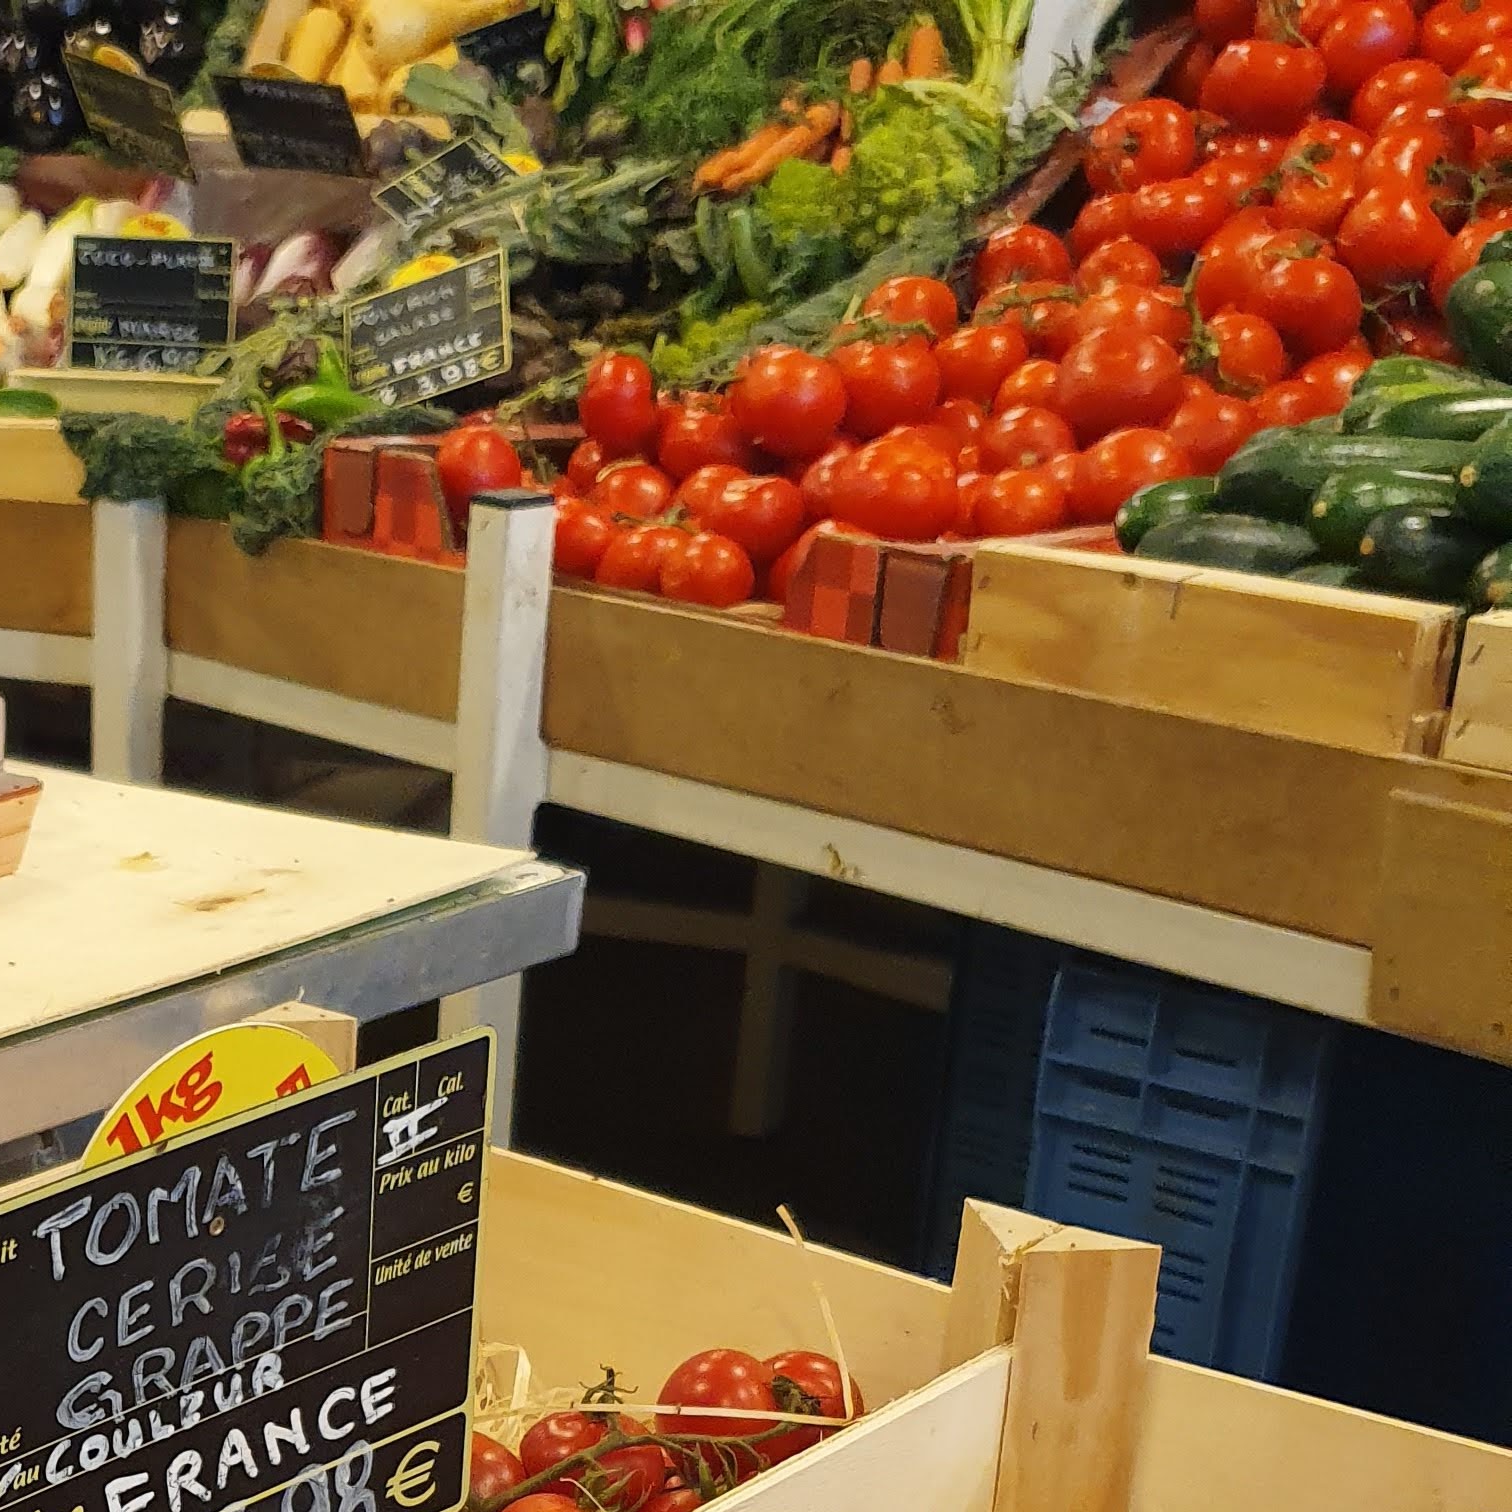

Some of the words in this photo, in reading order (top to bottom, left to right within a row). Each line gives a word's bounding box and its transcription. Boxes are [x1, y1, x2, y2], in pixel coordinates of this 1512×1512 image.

[392, 329, 484, 375] FRANCE
[106, 1050, 223, 1156] 1kg
[382, 1091, 412, 1118] Cat.
[437, 1071, 464, 1098] Cal.
[32, 1108, 358, 1282] TOMATE
[378, 1166, 414, 1195] Prix
[416, 1154, 441, 1181] au
[444, 1143, 476, 1170] kilo
[457, 1180, 475, 1204] €
[66, 1205, 346, 1363] CERISE
[374, 1251, 413, 1287] Unité
[414, 1248, 431, 1270] de
[434, 1232, 473, 1261] vente
[54, 1276, 355, 1431] GRAPPE
[44, 1350, 286, 1486] COULEUR
[12, 1464, 41, 1491] au
[384, 1440, 442, 1508] €
